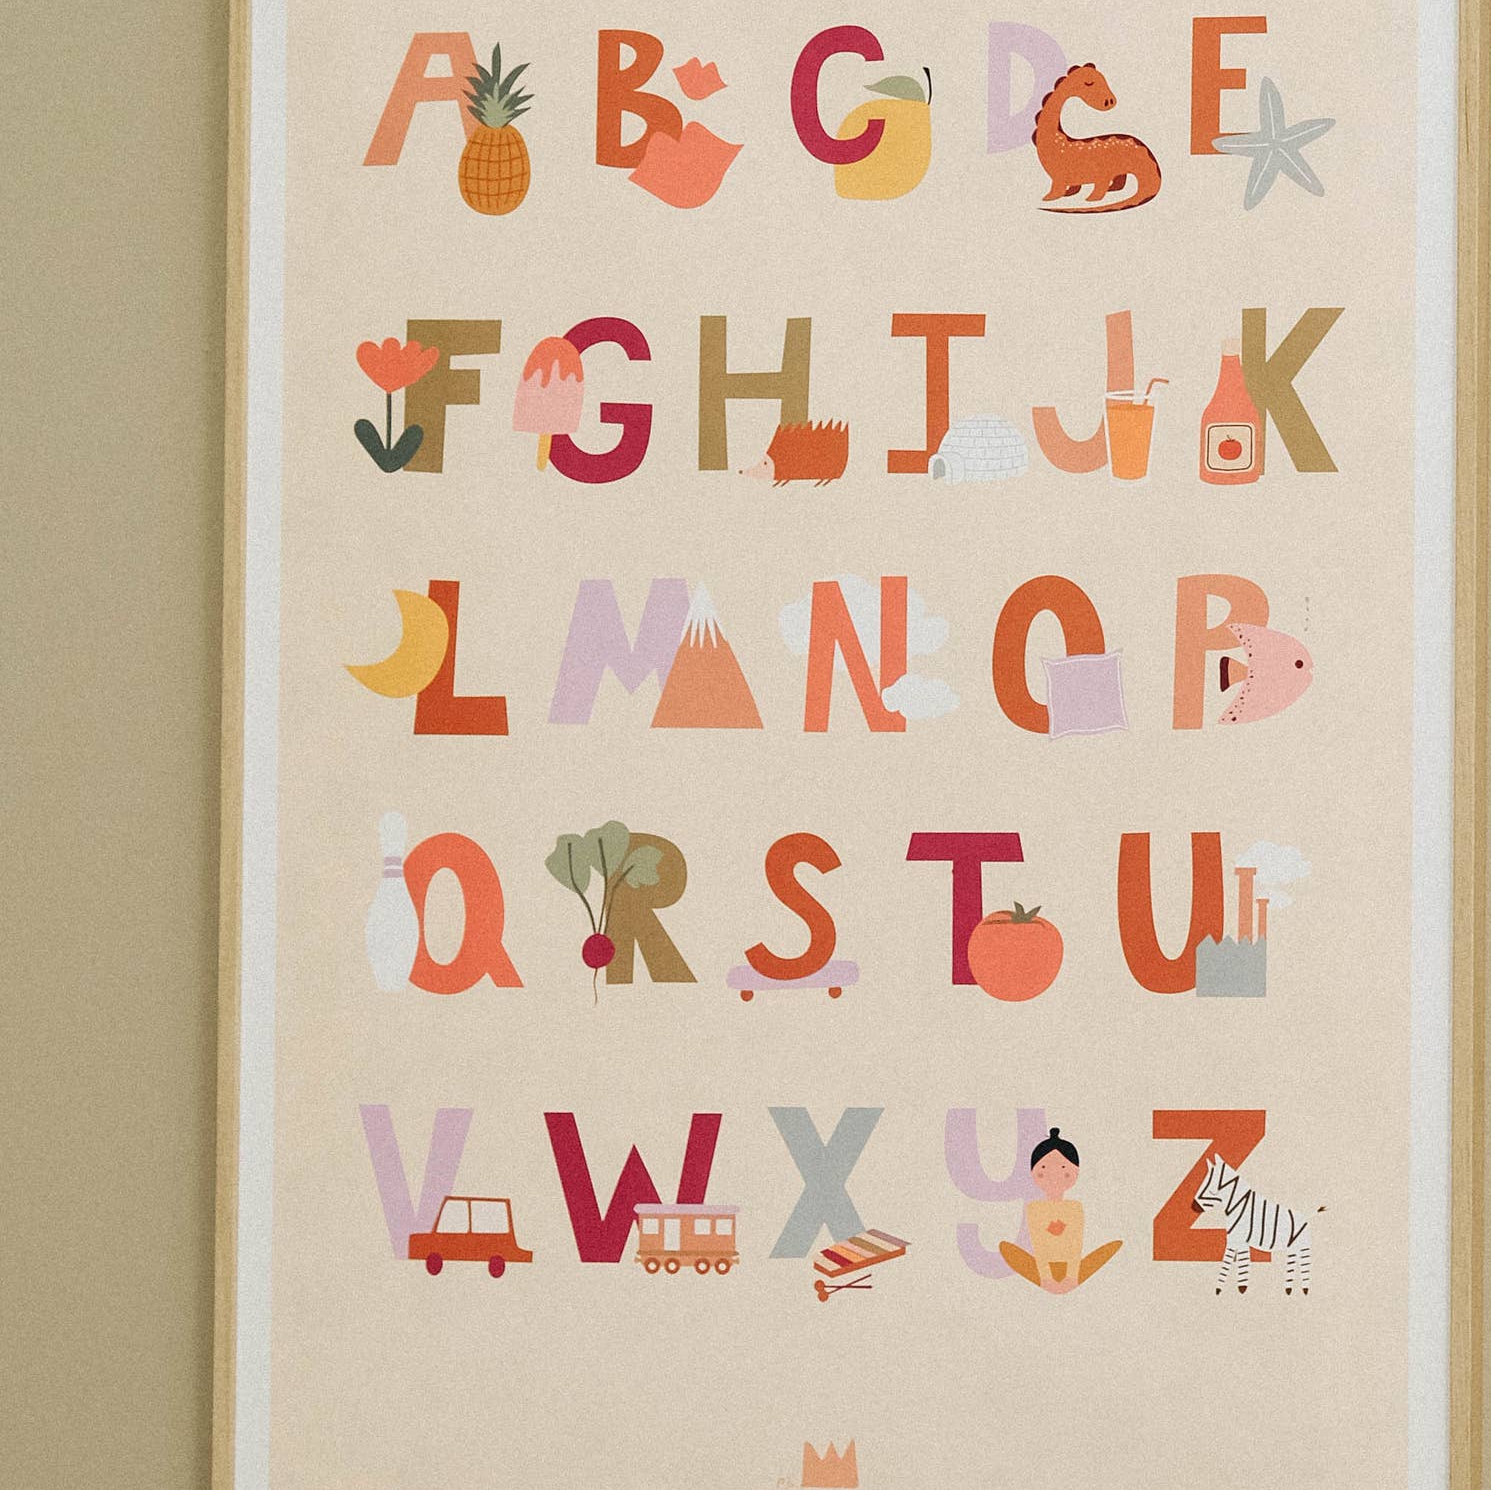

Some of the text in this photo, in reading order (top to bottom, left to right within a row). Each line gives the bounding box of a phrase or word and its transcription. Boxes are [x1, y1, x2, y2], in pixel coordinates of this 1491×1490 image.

[363, 16, 1267, 169] A B C D E
[403, 306, 1346, 484] F G H I J K
[413, 579, 509, 736] L
[547, 577, 695, 725] M
[803, 575, 909, 733] N
[1172, 573, 1270, 730] P
[402, 831, 1225, 995] Q R S T U
[358, 1104, 475, 1260] V
[544, 1111, 723, 1264] W
[767, 1106, 886, 1260] X
[1152, 1109, 1272, 1263] Z
